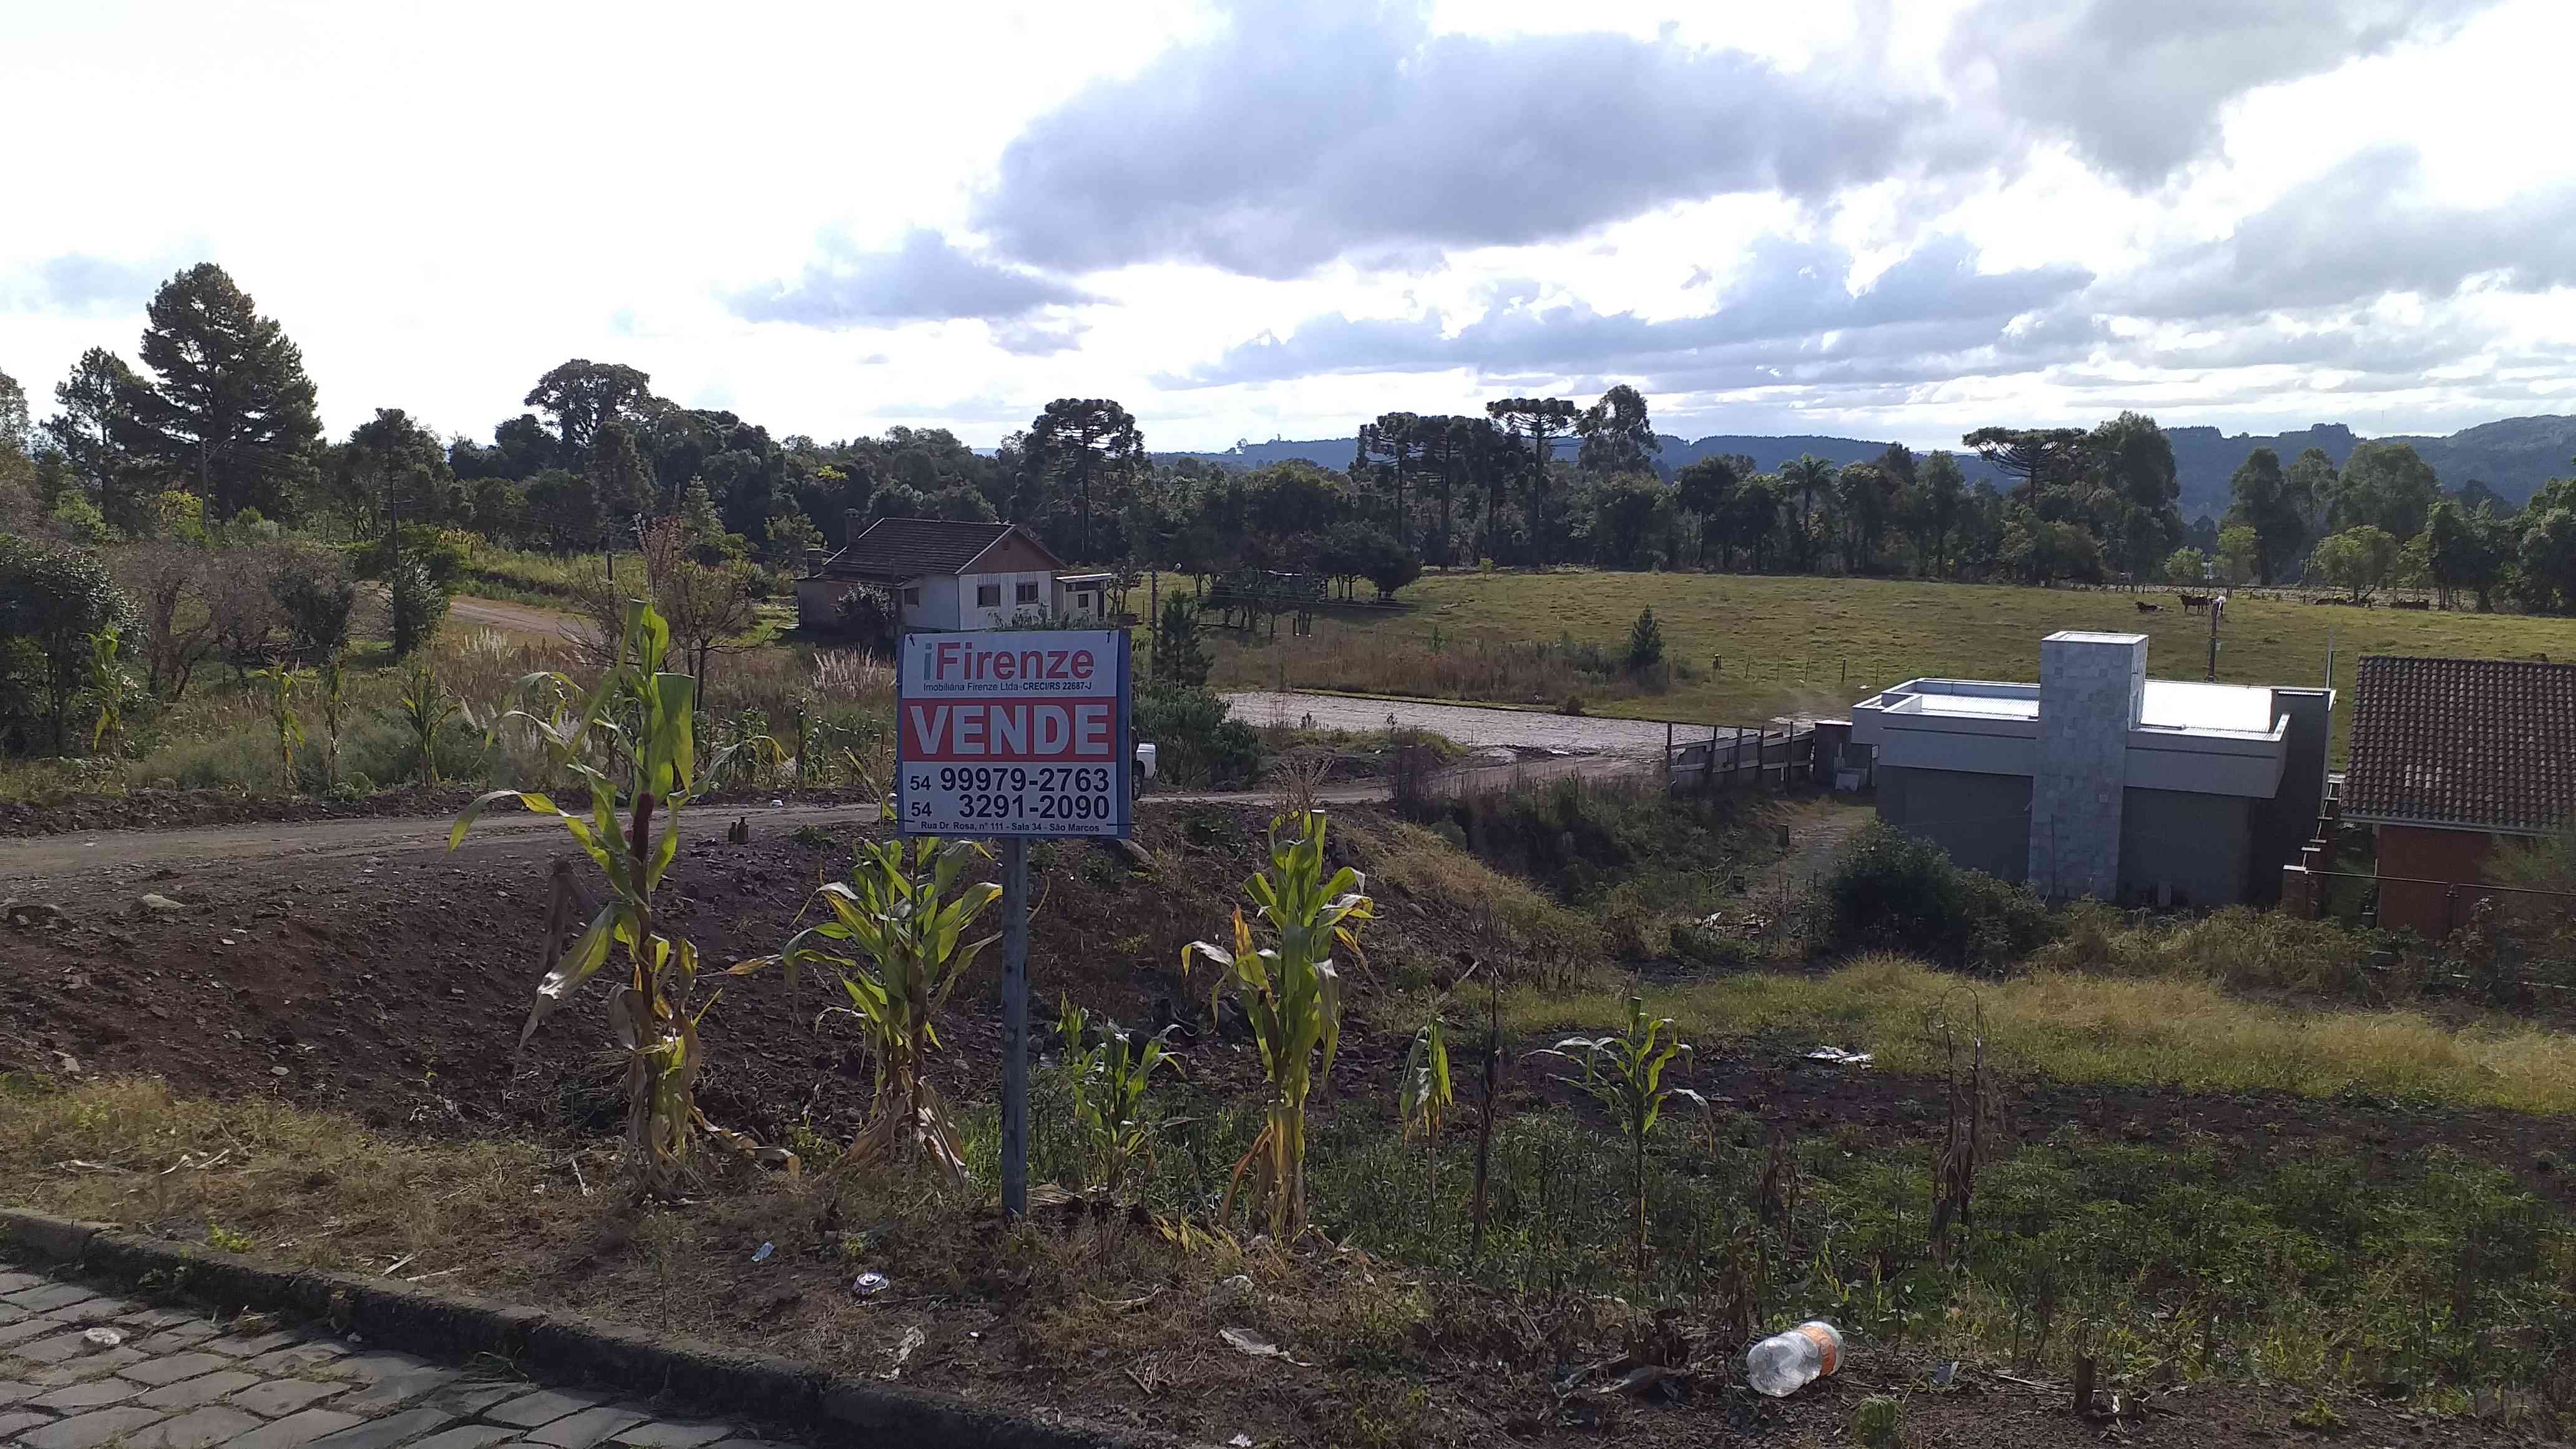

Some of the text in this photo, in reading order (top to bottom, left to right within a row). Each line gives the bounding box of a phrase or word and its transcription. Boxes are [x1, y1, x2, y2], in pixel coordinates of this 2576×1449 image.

[924, 642, 1095, 680] iFirenze
[967, 683, 998, 691] Firenze
[1000, 682, 1019, 690] Ltda
[1023, 682, 1061, 690] CRECI/RS
[1062, 681, 1091, 690] 22687-J
[909, 705, 1108, 754] VENDE
[910, 768, 1109, 792] 54 99979-2763
[911, 795, 1110, 819] 54 3291-2090
[921, 821, 937, 829] Rua
[953, 822, 977, 831] Rosa,
[1068, 824, 1100, 832] Marcos
